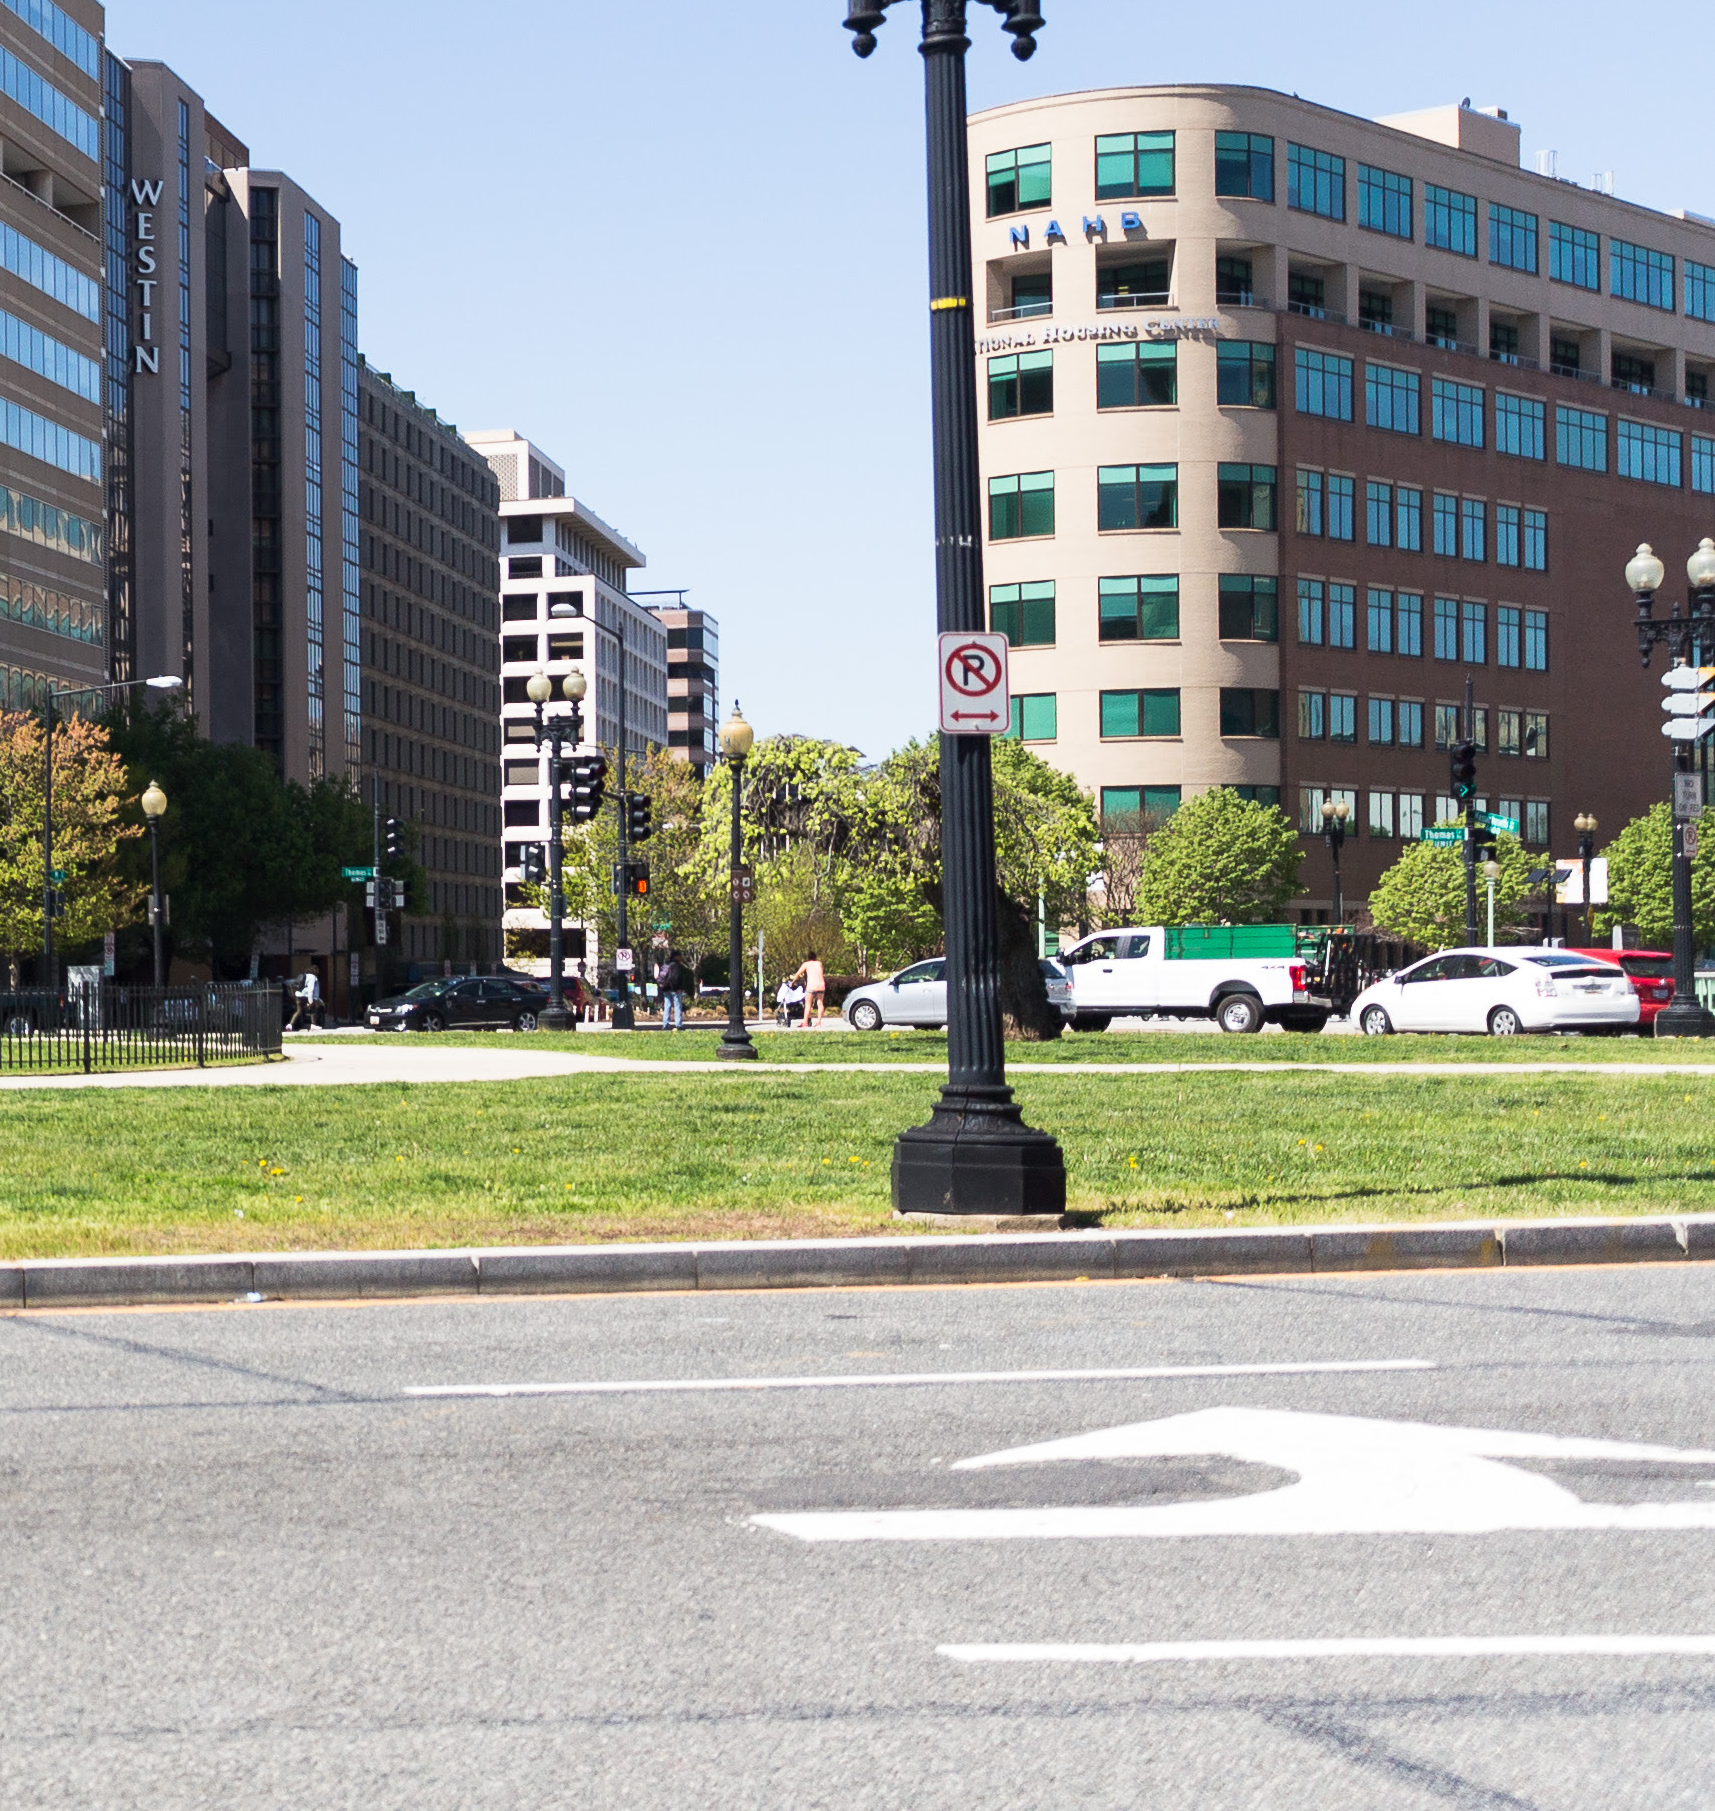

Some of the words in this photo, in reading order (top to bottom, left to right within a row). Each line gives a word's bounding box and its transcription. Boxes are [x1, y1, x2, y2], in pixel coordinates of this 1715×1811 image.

[1009, 211, 1141, 243] NAHB
[131, 178, 164, 374] WESTIN
[1142, 316, 1219, 332] CENTER
